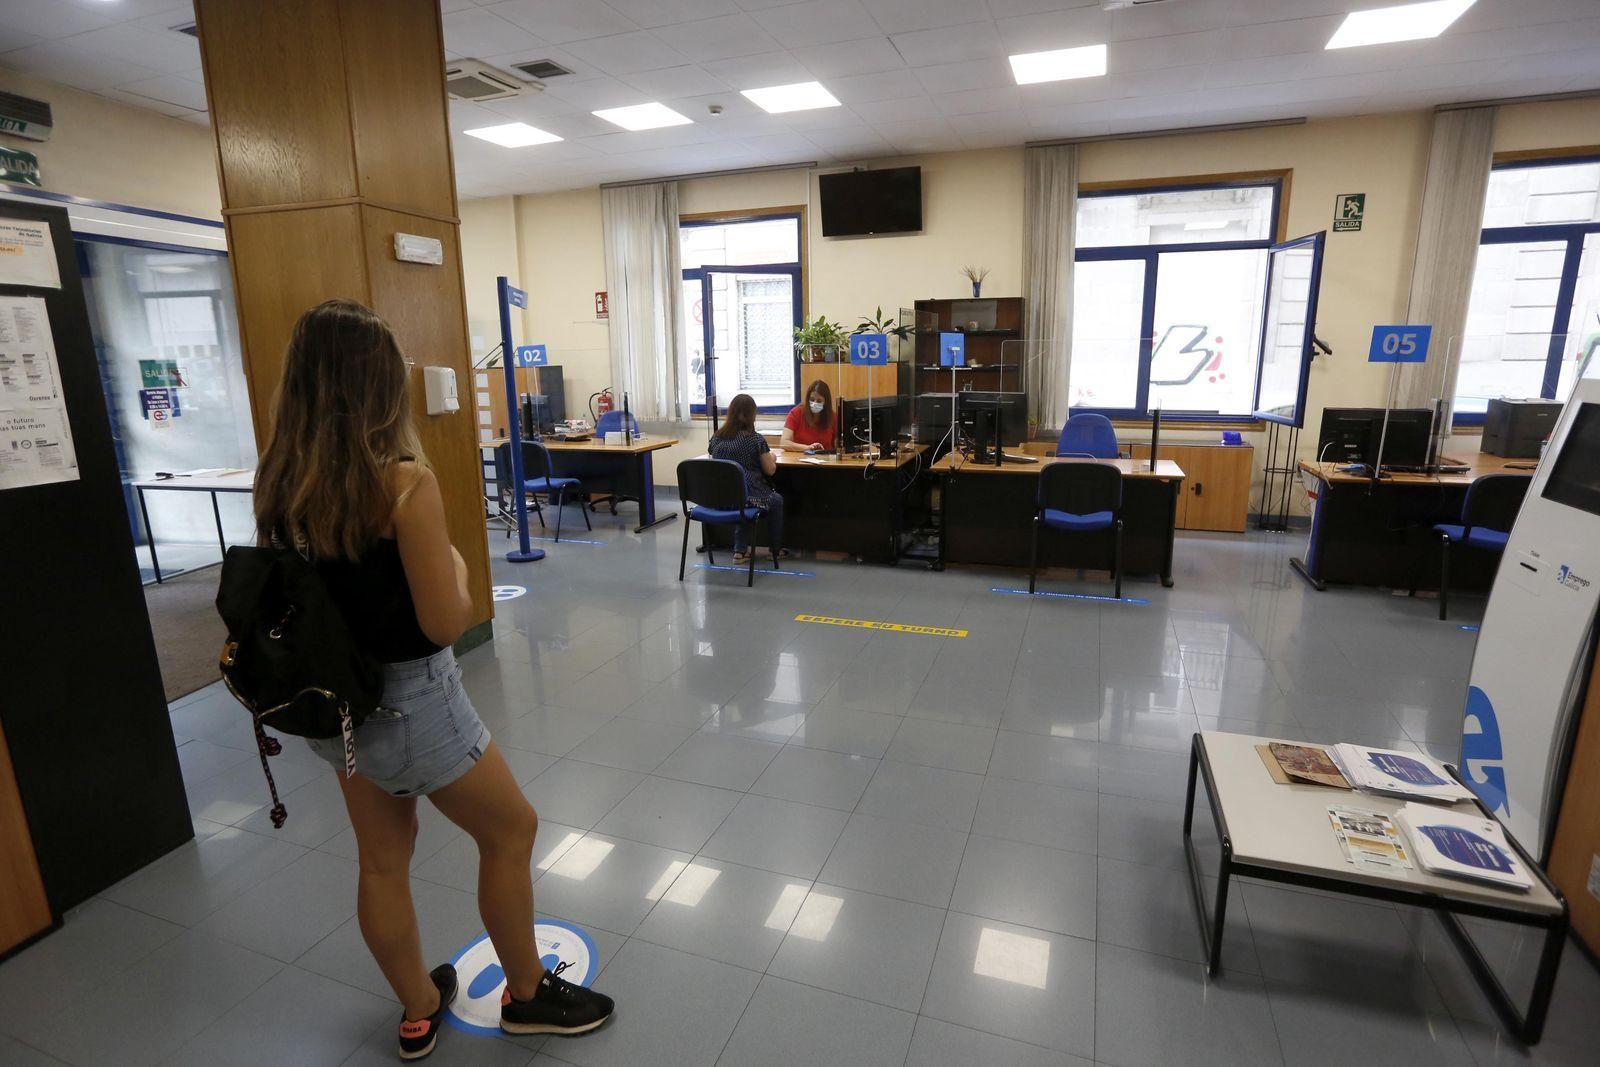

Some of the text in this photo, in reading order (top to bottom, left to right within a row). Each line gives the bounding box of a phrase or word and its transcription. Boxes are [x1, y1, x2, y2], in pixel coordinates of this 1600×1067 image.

[0, 119, 19, 131] IDA
[858, 341, 880, 359] 03
[1382, 333, 1416, 355] 05
[523, 350, 541, 362] 02
[1567, 571, 1591, 588] Emprego
[802, 615, 960, 636] ESPERE SU TURNO
